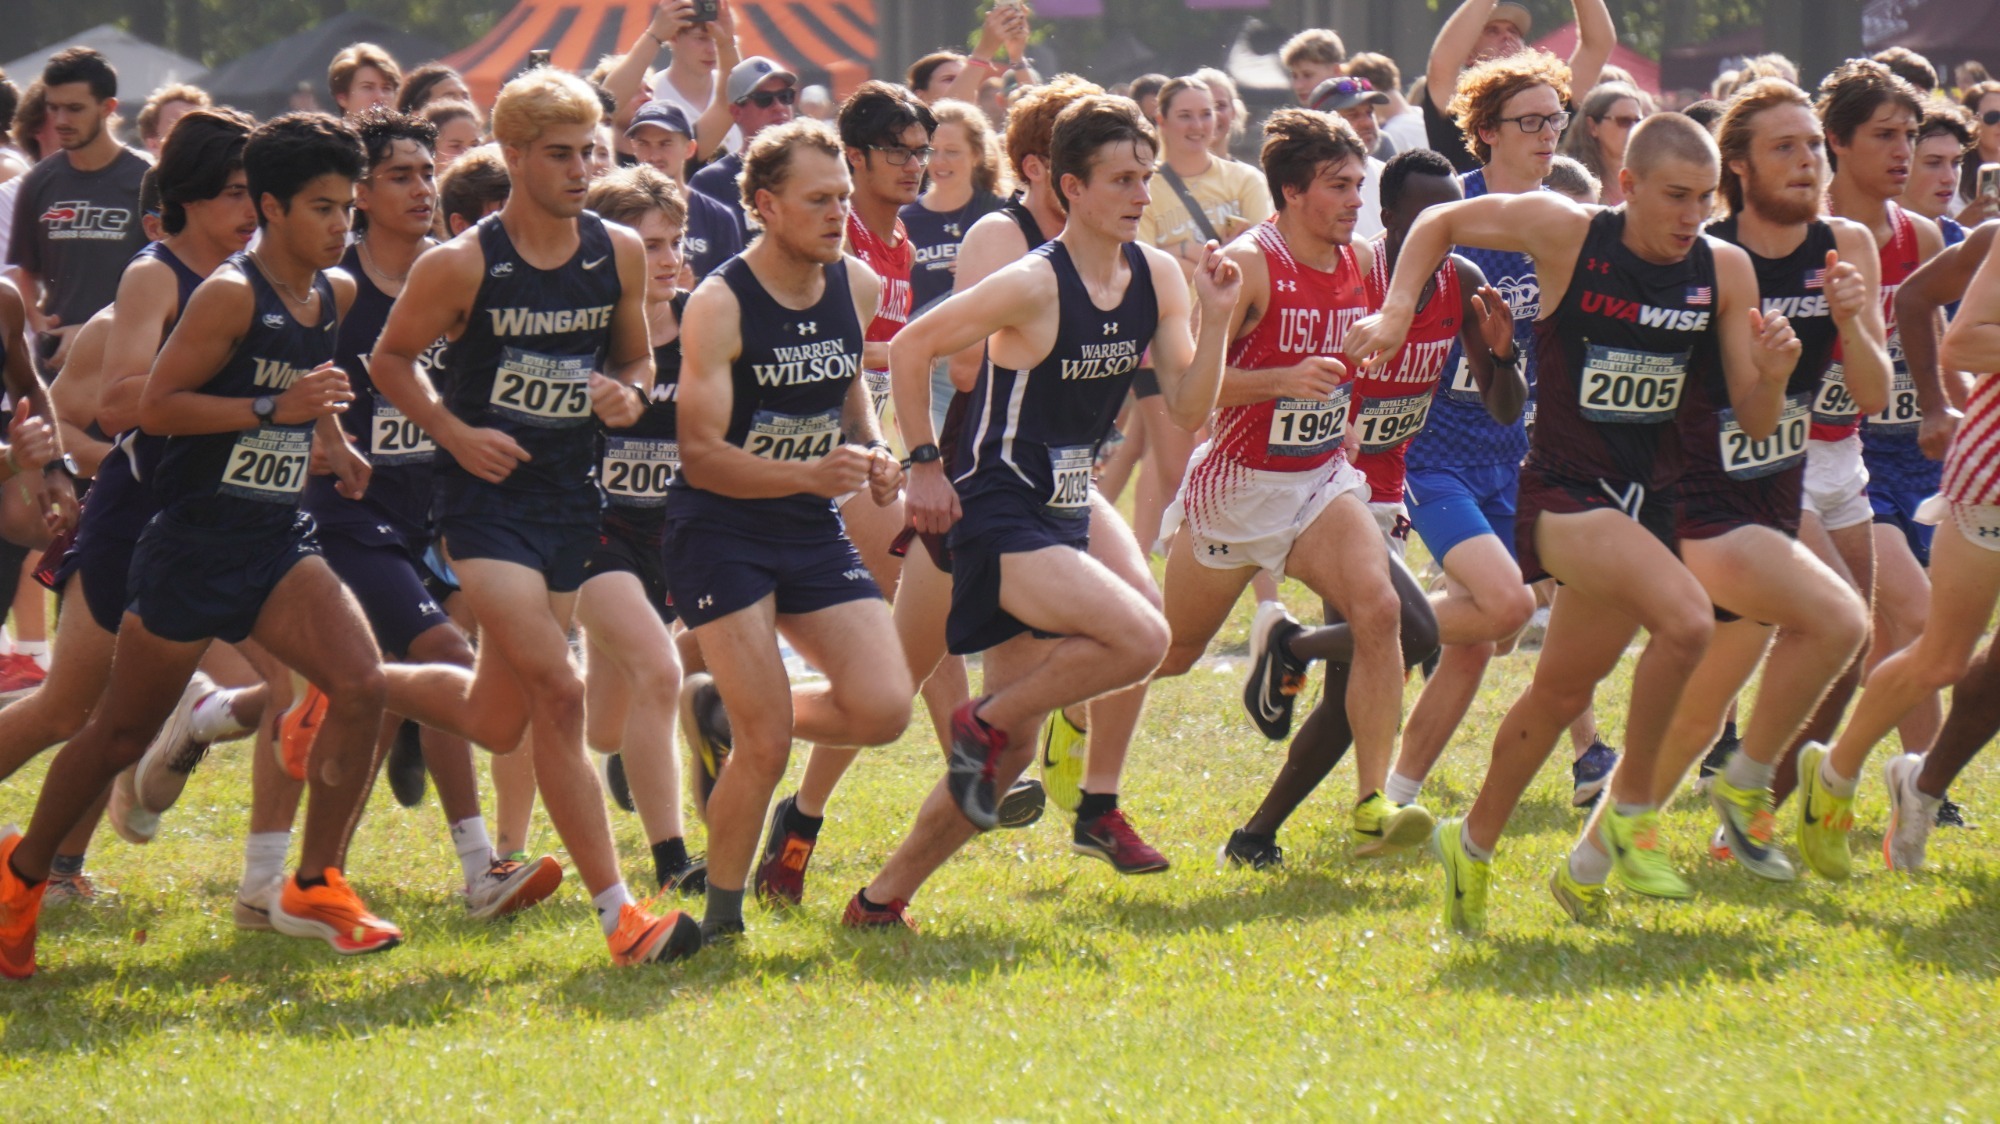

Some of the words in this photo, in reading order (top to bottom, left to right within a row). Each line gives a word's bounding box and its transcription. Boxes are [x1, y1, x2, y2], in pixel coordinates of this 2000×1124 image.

[46, 200, 131, 230] Fire
[48, 230, 78, 239] CROSS
[79, 231, 126, 240] COUNTRY
[1763, 295, 1830, 318] WISE
[485, 304, 615, 336] WINGATE
[1279, 308, 1320, 354] USC
[521, 354, 557, 369] ROYALS
[772, 338, 844, 363] WARREN
[1081, 340, 1137, 360] WARREN
[1607, 351, 1642, 363] ROYALS
[1644, 355, 1674, 366] CROSS
[504, 361, 548, 377] COUNTRY
[752, 353, 858, 387] WILSON
[1590, 359, 1634, 372] COUNTRY
[499, 373, 588, 414] 2075
[1379, 398, 1408, 408] ROYALS
[1587, 373, 1678, 409] 2005
[1280, 400, 1316, 410] COUNTRY
[1363, 406, 1400, 415] COUNTRY
[1280, 406, 1346, 442] 1992
[1362, 406, 1428, 442] 1994
[241, 436, 279, 450] COUNTRY
[608, 449, 649, 460] COUNTRY
[623, 441, 656, 451] ROYALS
[750, 432, 833, 462] 2044
[1728, 418, 1806, 467] 2010
[230, 450, 306, 489] 2067
[1052, 470, 1089, 504] 2039
